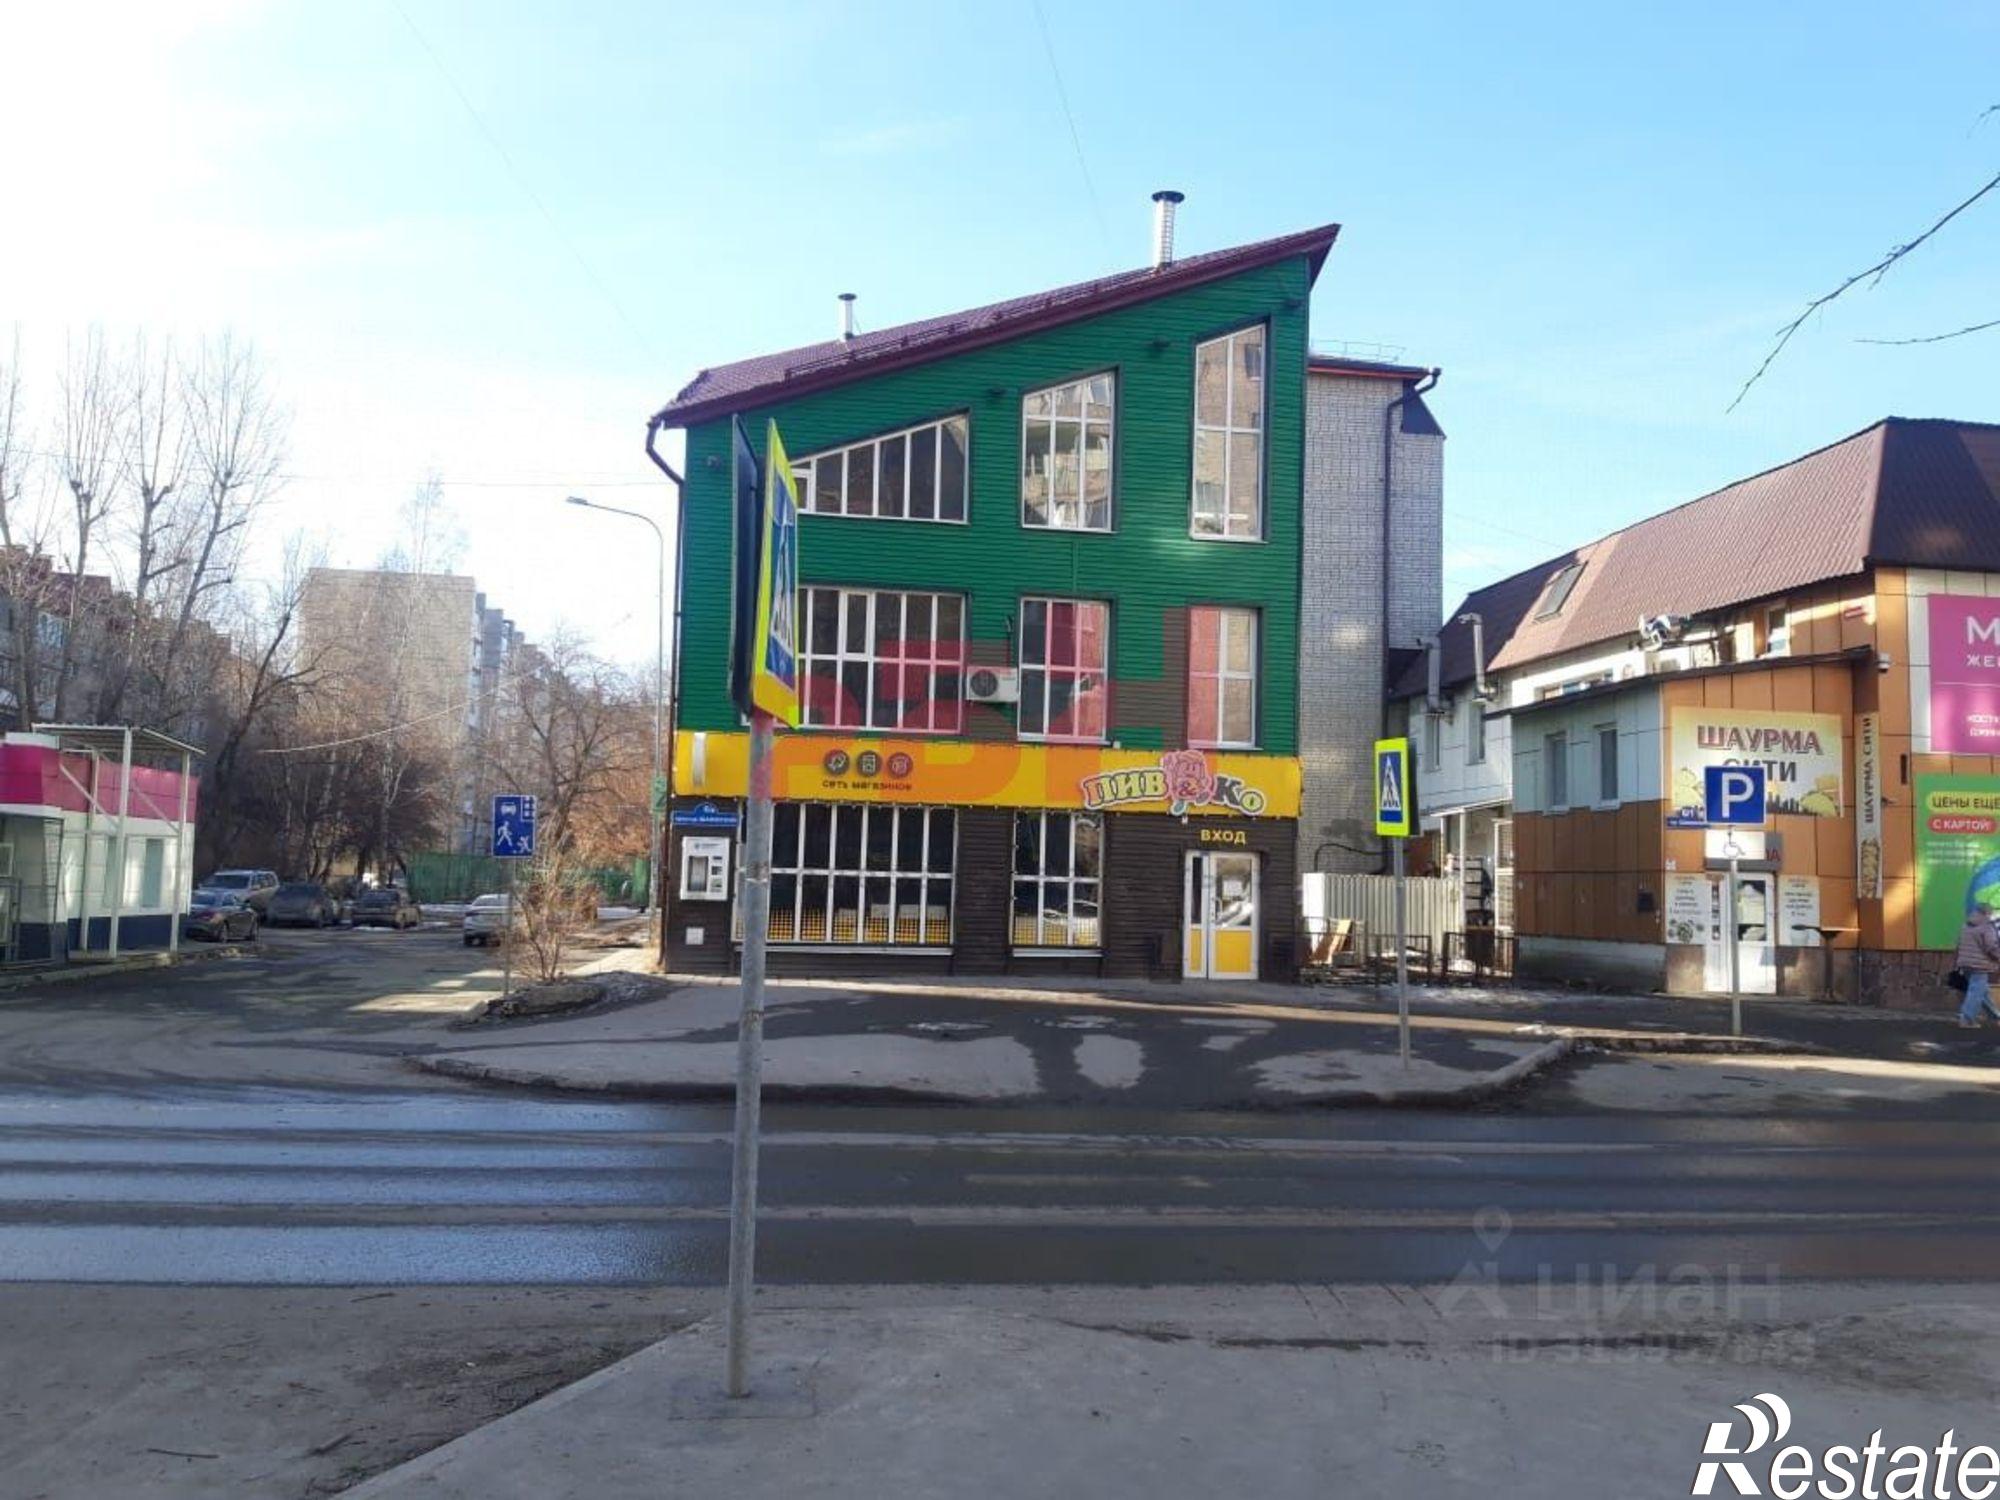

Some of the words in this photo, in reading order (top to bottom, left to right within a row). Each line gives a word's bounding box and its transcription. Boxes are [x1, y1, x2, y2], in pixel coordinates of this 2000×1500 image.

[1697, 724, 1824, 755] ШАУРМА
[1863, 717, 1873, 756] СИТИ
[1864, 759, 1875, 823] ШАУРМА
[1932, 796, 1970, 808] ЦЕНЫ
[1932, 819, 1941, 829] С
[1200, 829, 1247, 845] ВХОД
